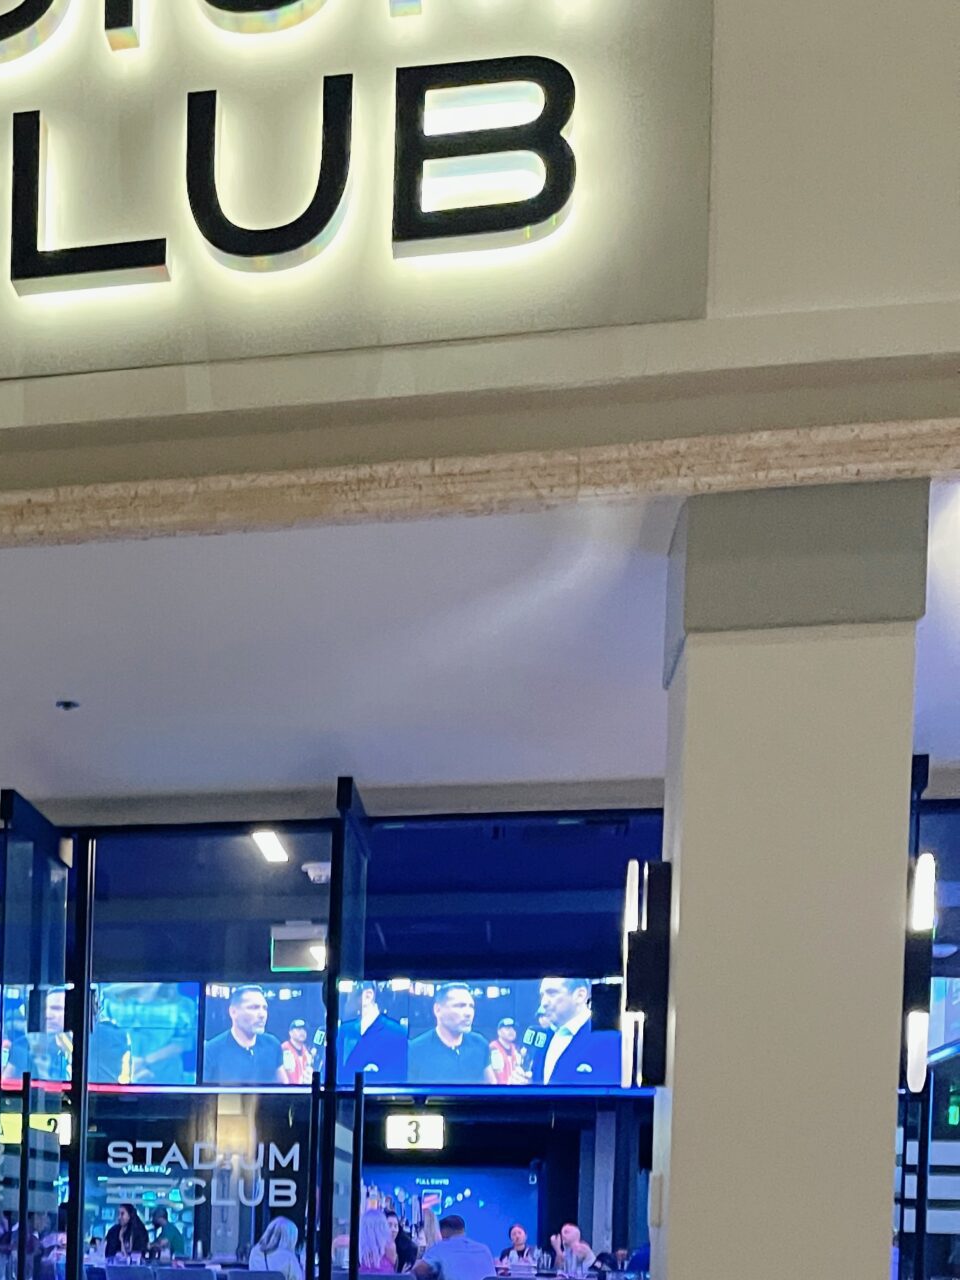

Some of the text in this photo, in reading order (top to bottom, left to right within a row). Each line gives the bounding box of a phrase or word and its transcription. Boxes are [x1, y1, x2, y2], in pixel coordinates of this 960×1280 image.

[406, 1120, 420, 1145] 3
[107, 1140, 300, 1172] STADUM
[181, 1177, 298, 1208] CLUB
